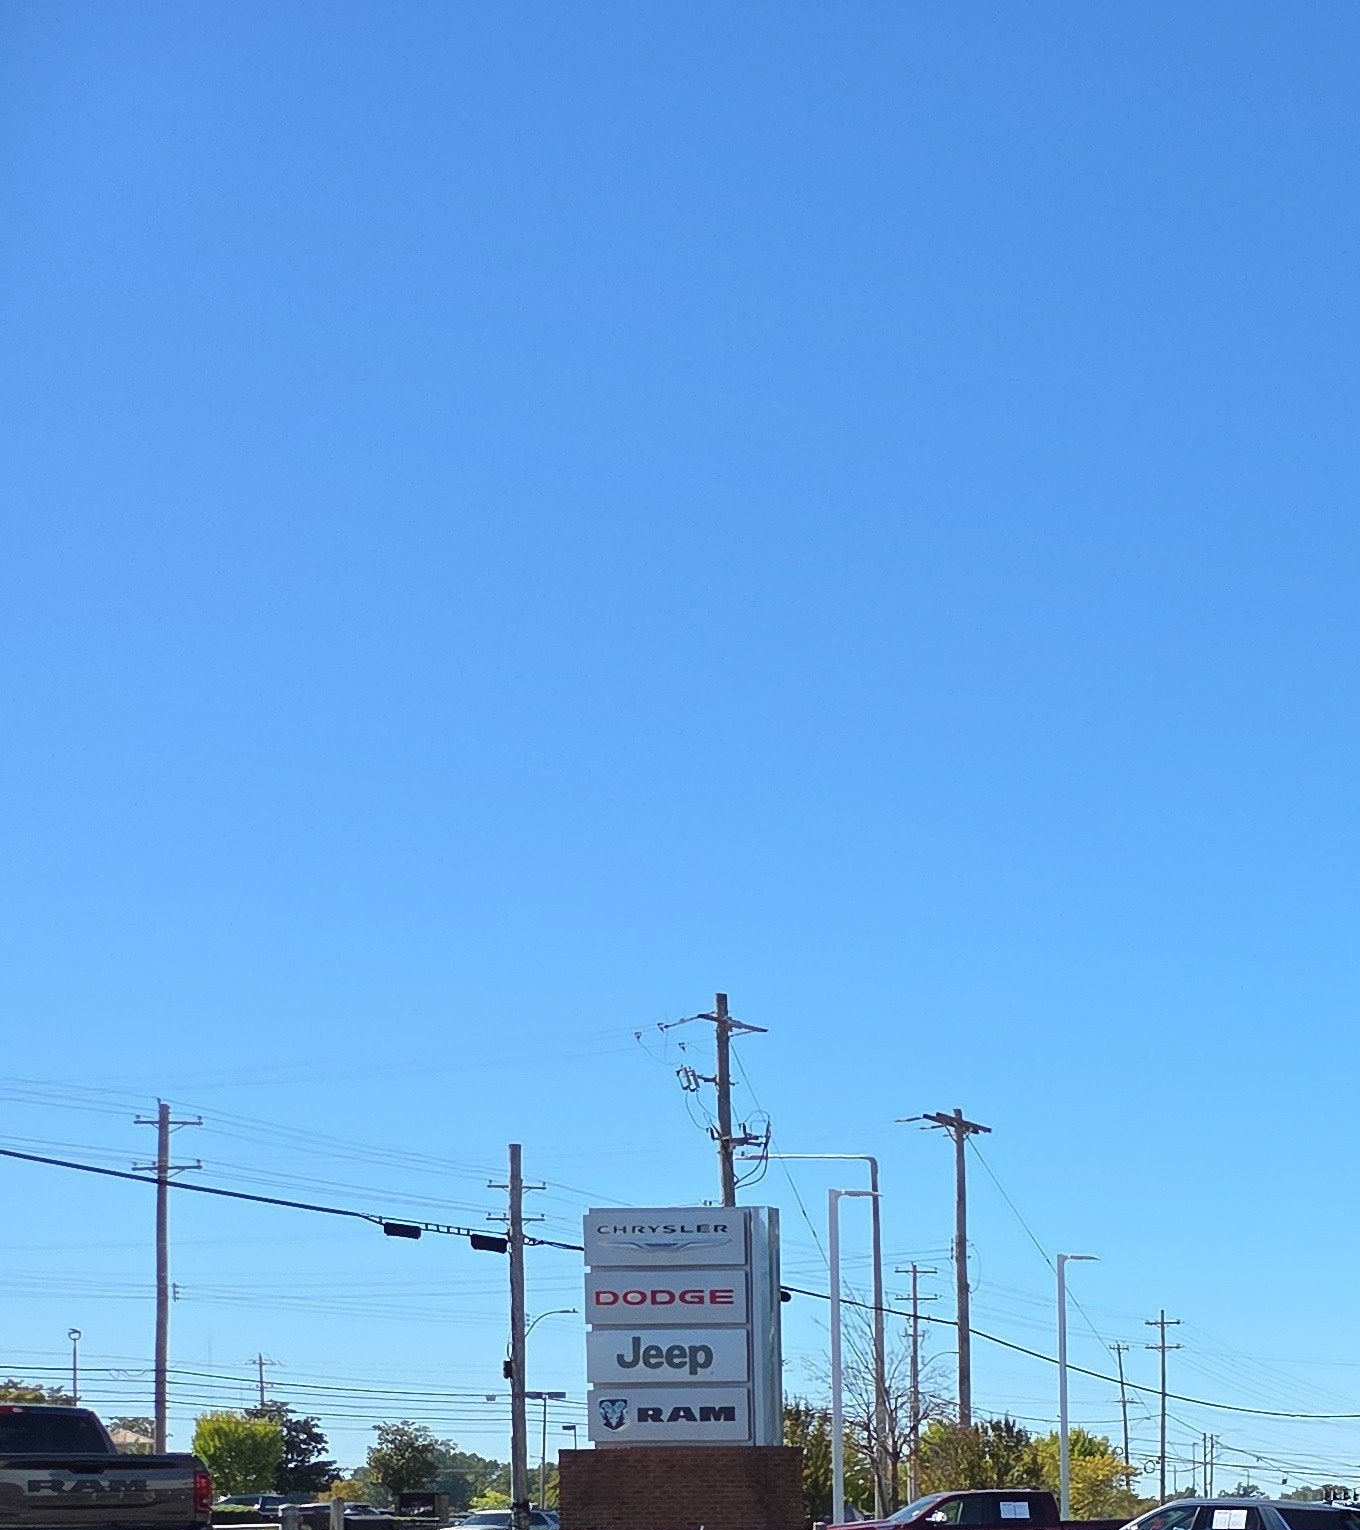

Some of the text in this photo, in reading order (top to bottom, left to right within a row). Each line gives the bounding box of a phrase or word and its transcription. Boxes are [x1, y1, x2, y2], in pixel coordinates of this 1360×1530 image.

[596, 1223, 729, 1235] CHRYSLER
[594, 1288, 735, 1306] DODGE
[616, 1336, 714, 1376] Jeep
[636, 1406, 736, 1423] RAM
[27, 1479, 147, 1493] RAM
